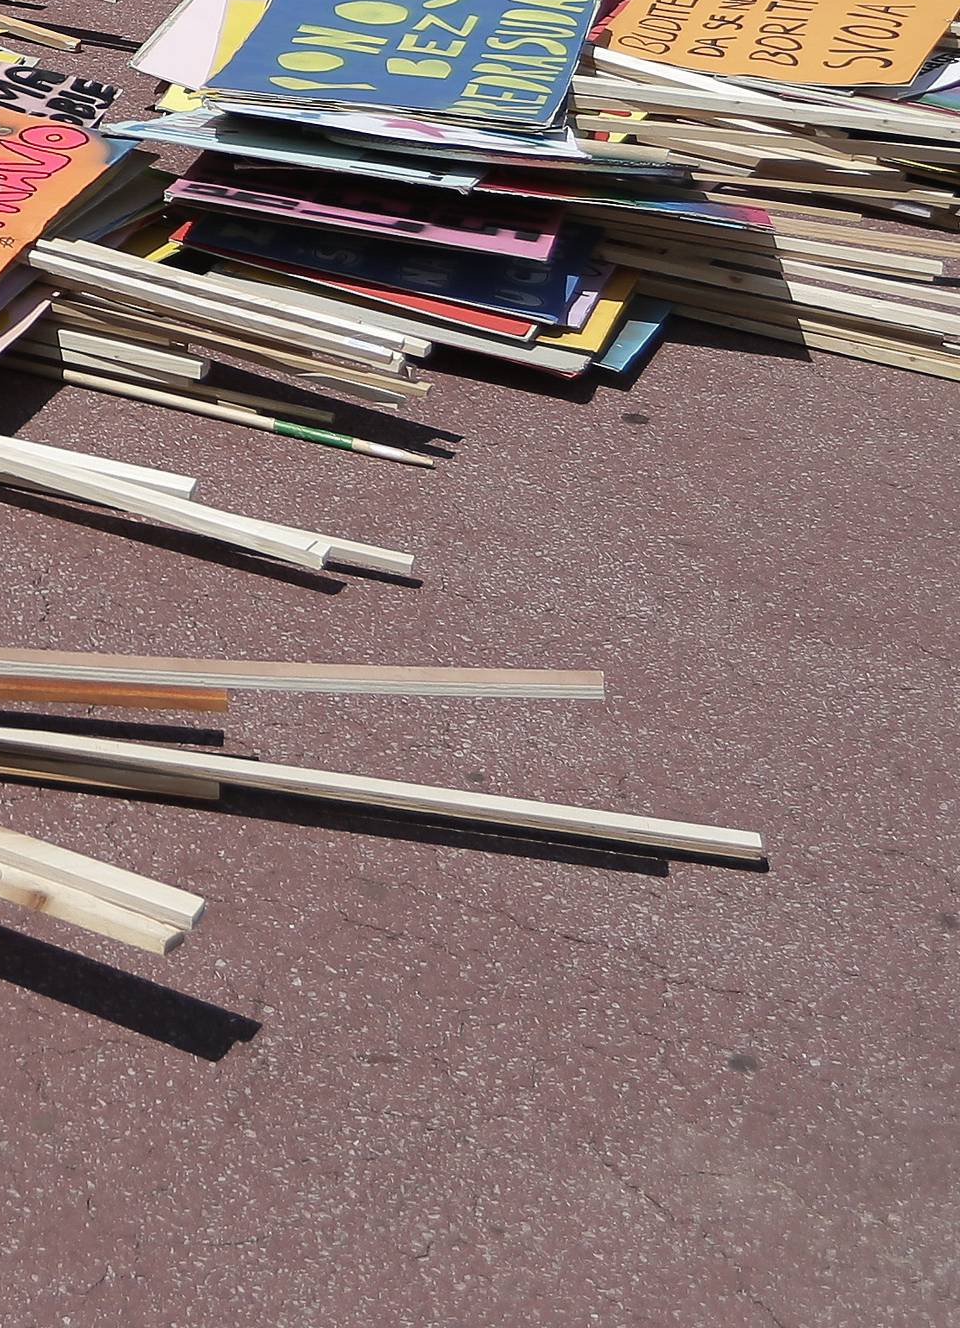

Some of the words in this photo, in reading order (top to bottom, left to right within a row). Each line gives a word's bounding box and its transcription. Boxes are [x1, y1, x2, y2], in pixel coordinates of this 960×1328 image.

[702, 14, 744, 32] SE
[823, 2, 916, 69] SVOJA
[385, 13, 478, 79] BEZ
[687, 35, 738, 59] DA
